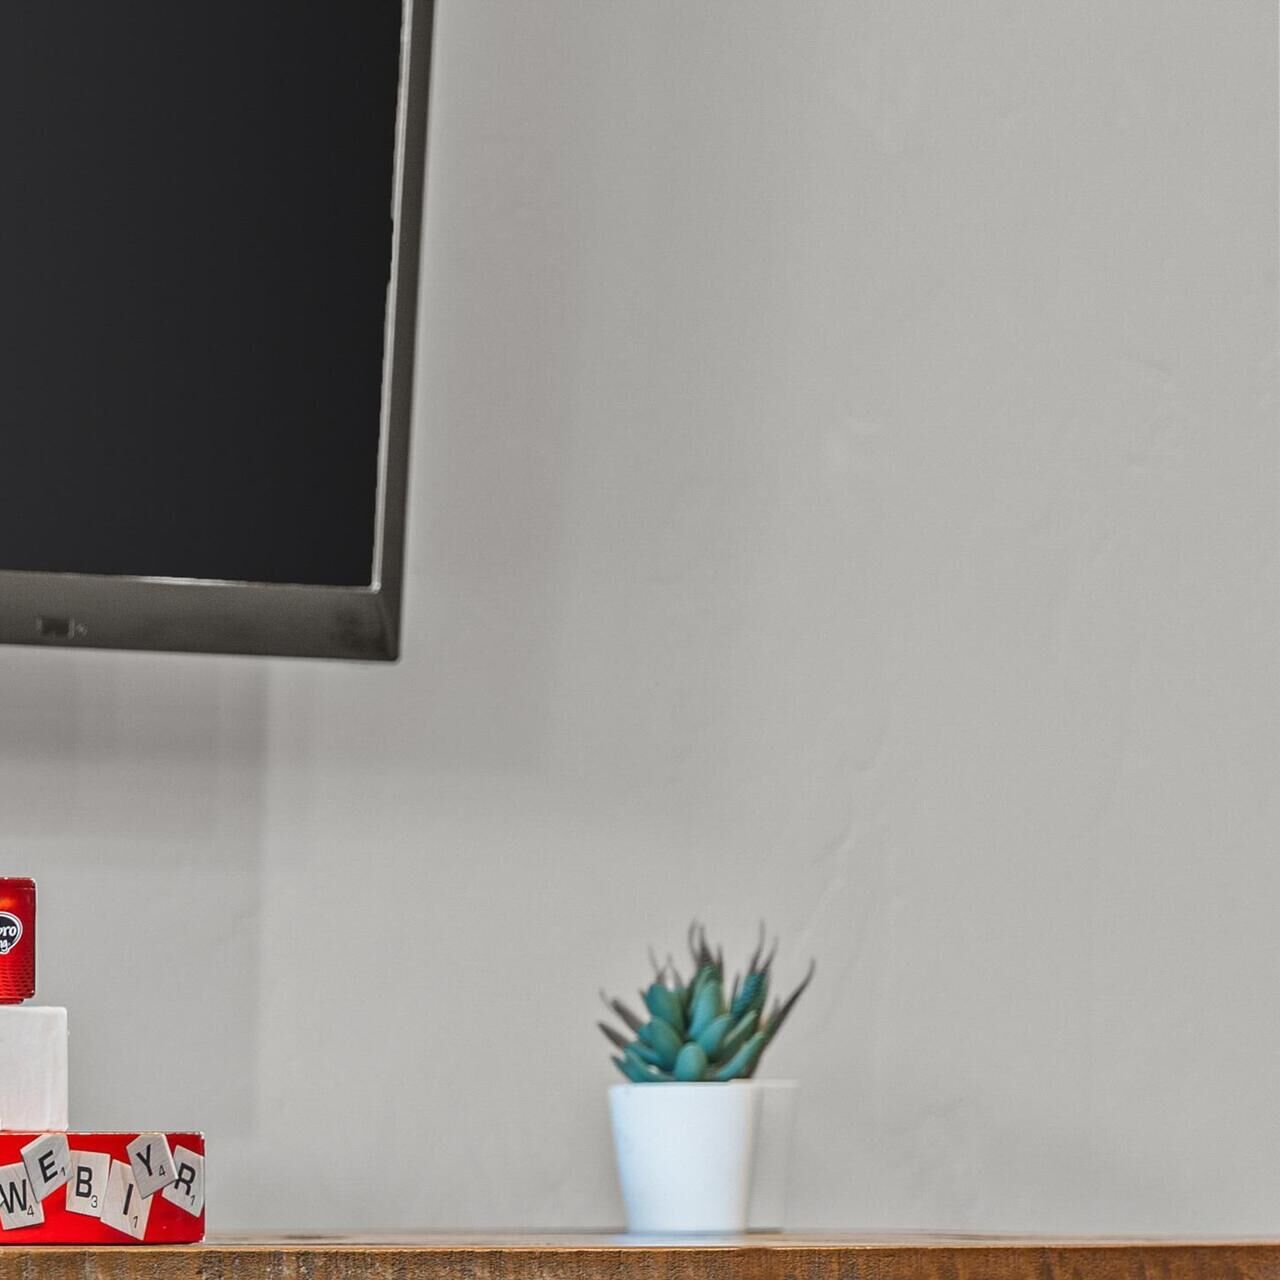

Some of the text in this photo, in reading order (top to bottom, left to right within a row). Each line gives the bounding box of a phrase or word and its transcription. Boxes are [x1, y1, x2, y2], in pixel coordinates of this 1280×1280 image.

[38, 1150, 58, 1183] E
[136, 1144, 152, 1177] Y
[75, 1166, 92, 1198] B
[174, 1162, 196, 1196] R
